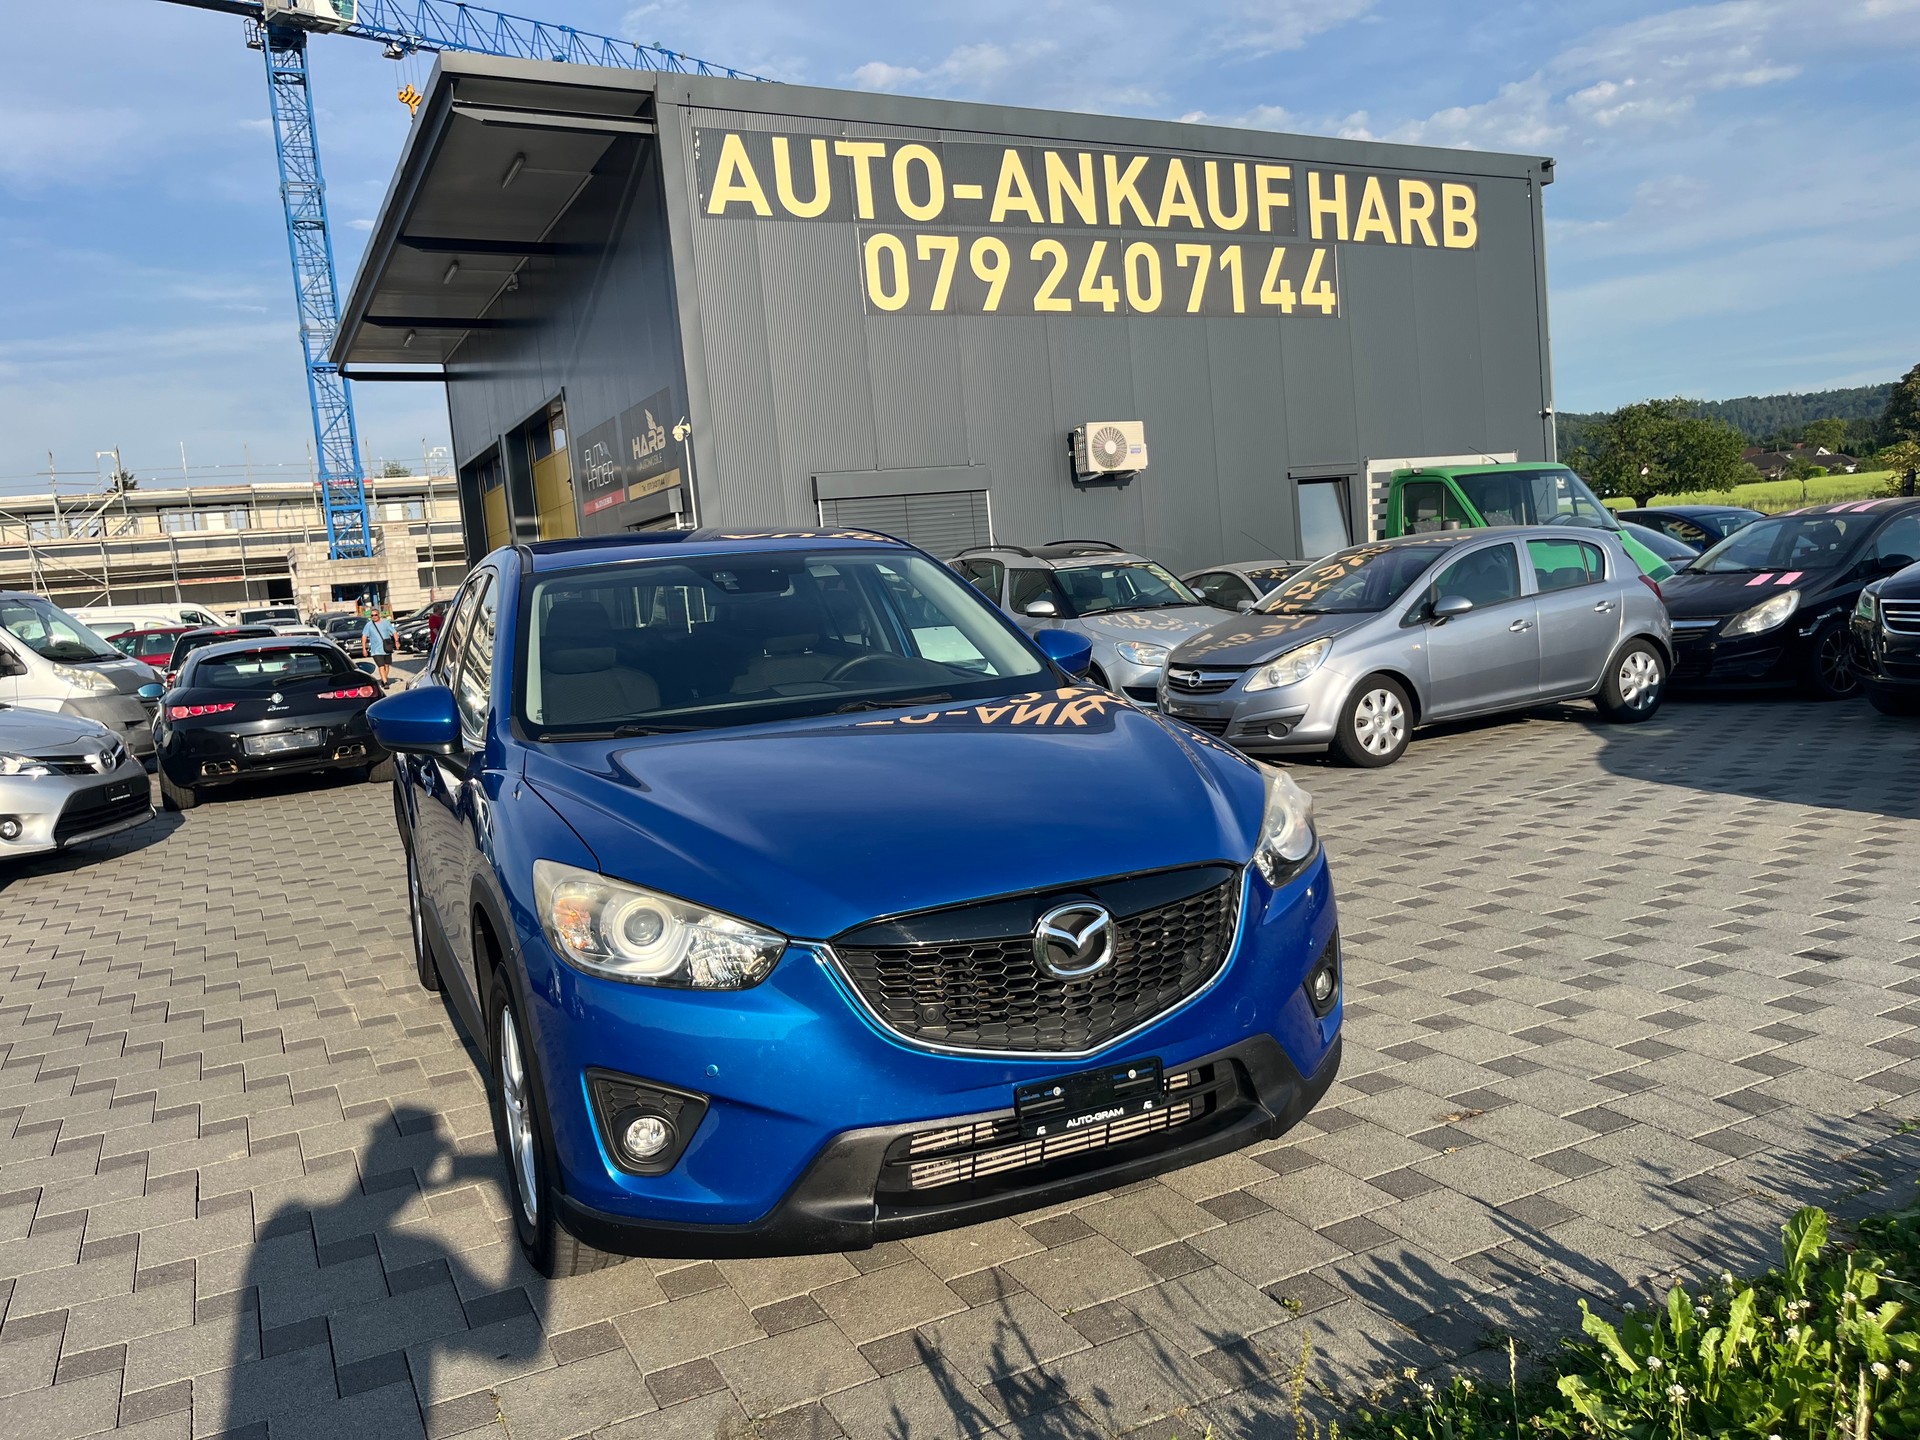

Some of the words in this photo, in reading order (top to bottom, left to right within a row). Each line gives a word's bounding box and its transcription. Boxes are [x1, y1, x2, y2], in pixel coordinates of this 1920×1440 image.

[708, 134, 1291, 232] AUTO-ANKAUF
[1308, 171, 1478, 249] HARB
[865, 233, 1011, 311] 079
[1030, 239, 1163, 313] 240
[1175, 243, 1246, 314] 71
[1260, 247, 1336, 315] 44
[632, 426, 665, 460] HARB
[1066, 1107, 1124, 1128] AUTO-GRAM
